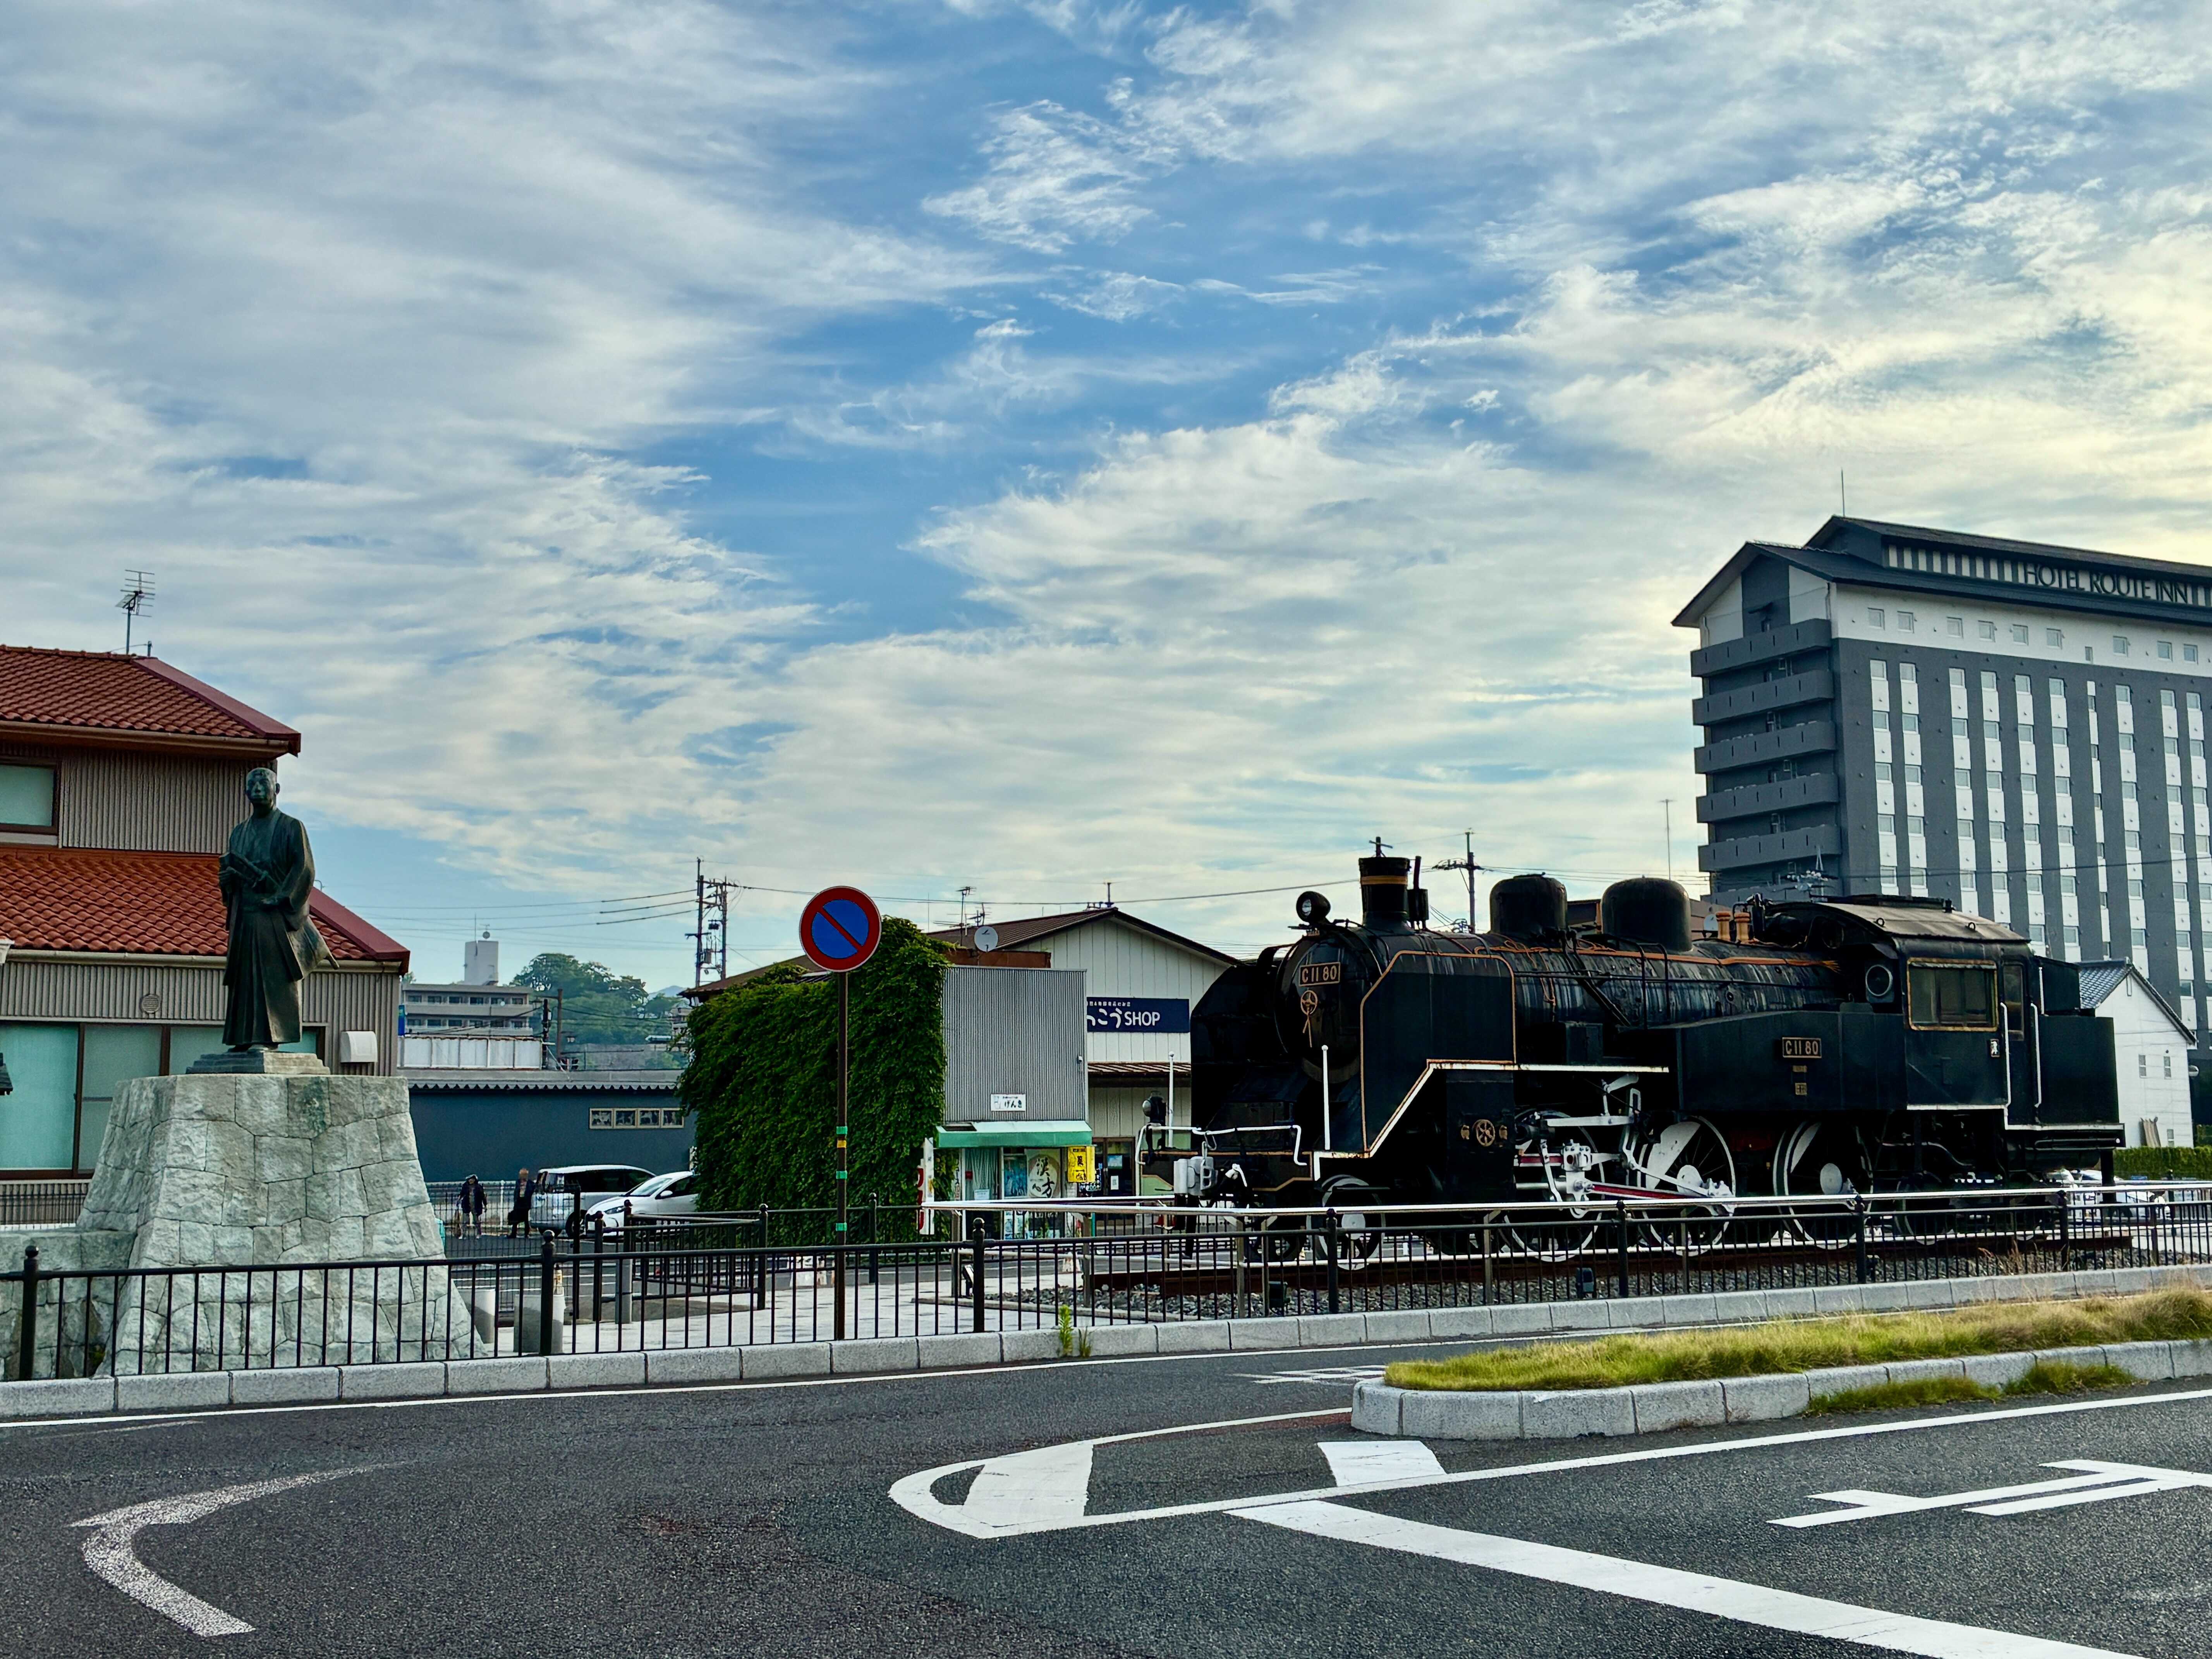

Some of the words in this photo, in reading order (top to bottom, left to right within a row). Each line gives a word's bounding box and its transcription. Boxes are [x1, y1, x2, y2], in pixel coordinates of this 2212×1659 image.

[2024, 562, 2085, 592] HOTEL
[2090, 571, 2152, 599] ROUTE
[2155, 579, 2188, 605] INN
[1322, 965, 1337, 981] 80
[1805, 1040, 1819, 1055] 80
